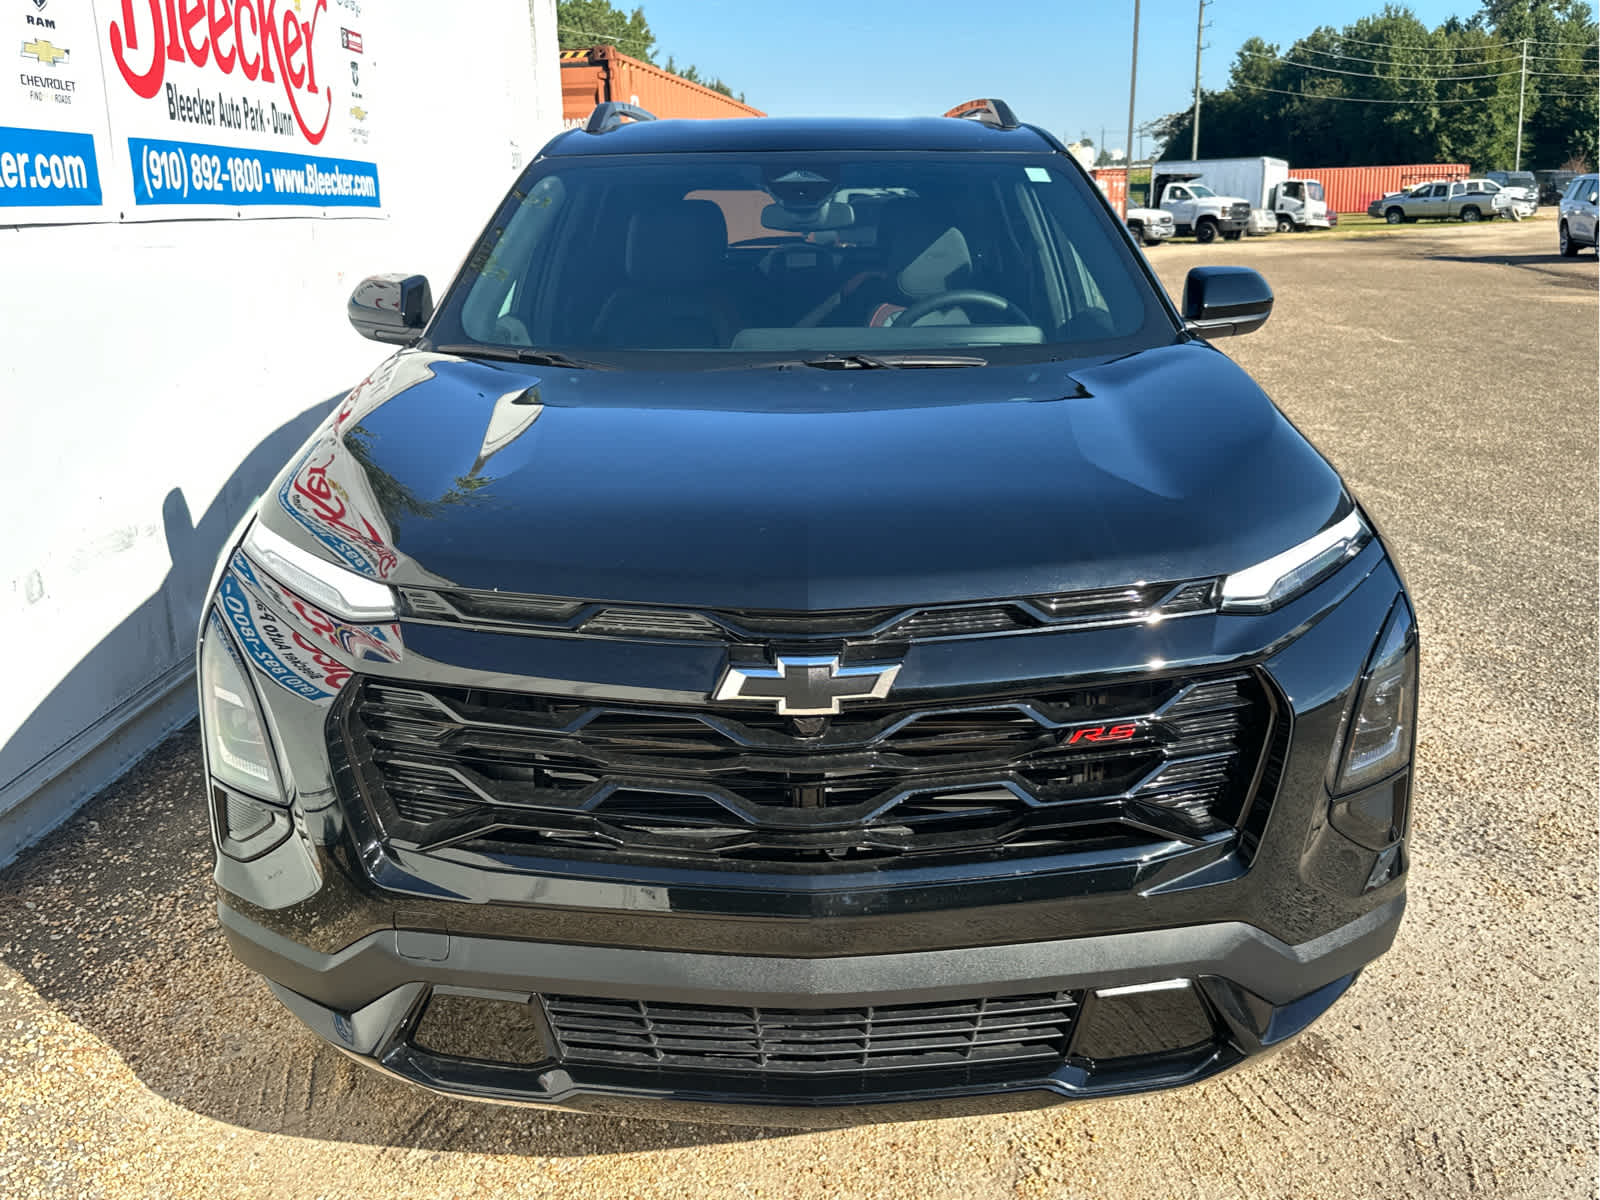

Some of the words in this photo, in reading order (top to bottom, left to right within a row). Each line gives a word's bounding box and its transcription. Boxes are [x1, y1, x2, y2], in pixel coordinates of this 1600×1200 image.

[26, 15, 56, 30] RAM
[20, 73, 76, 93] CHEVROLET
[166, 82, 216, 126] Bleecker
[219, 92, 241, 130] Auto
[242, 97, 266, 132] Park
[271, 102, 295, 137] Dunn
[0, 152, 88, 189] er.com
[142, 145, 187, 198] (910)
[191, 153, 263, 193] 892-1800
[272, 163, 376, 198] www.Bleecker.com
[1068, 723, 1137, 744] RS
